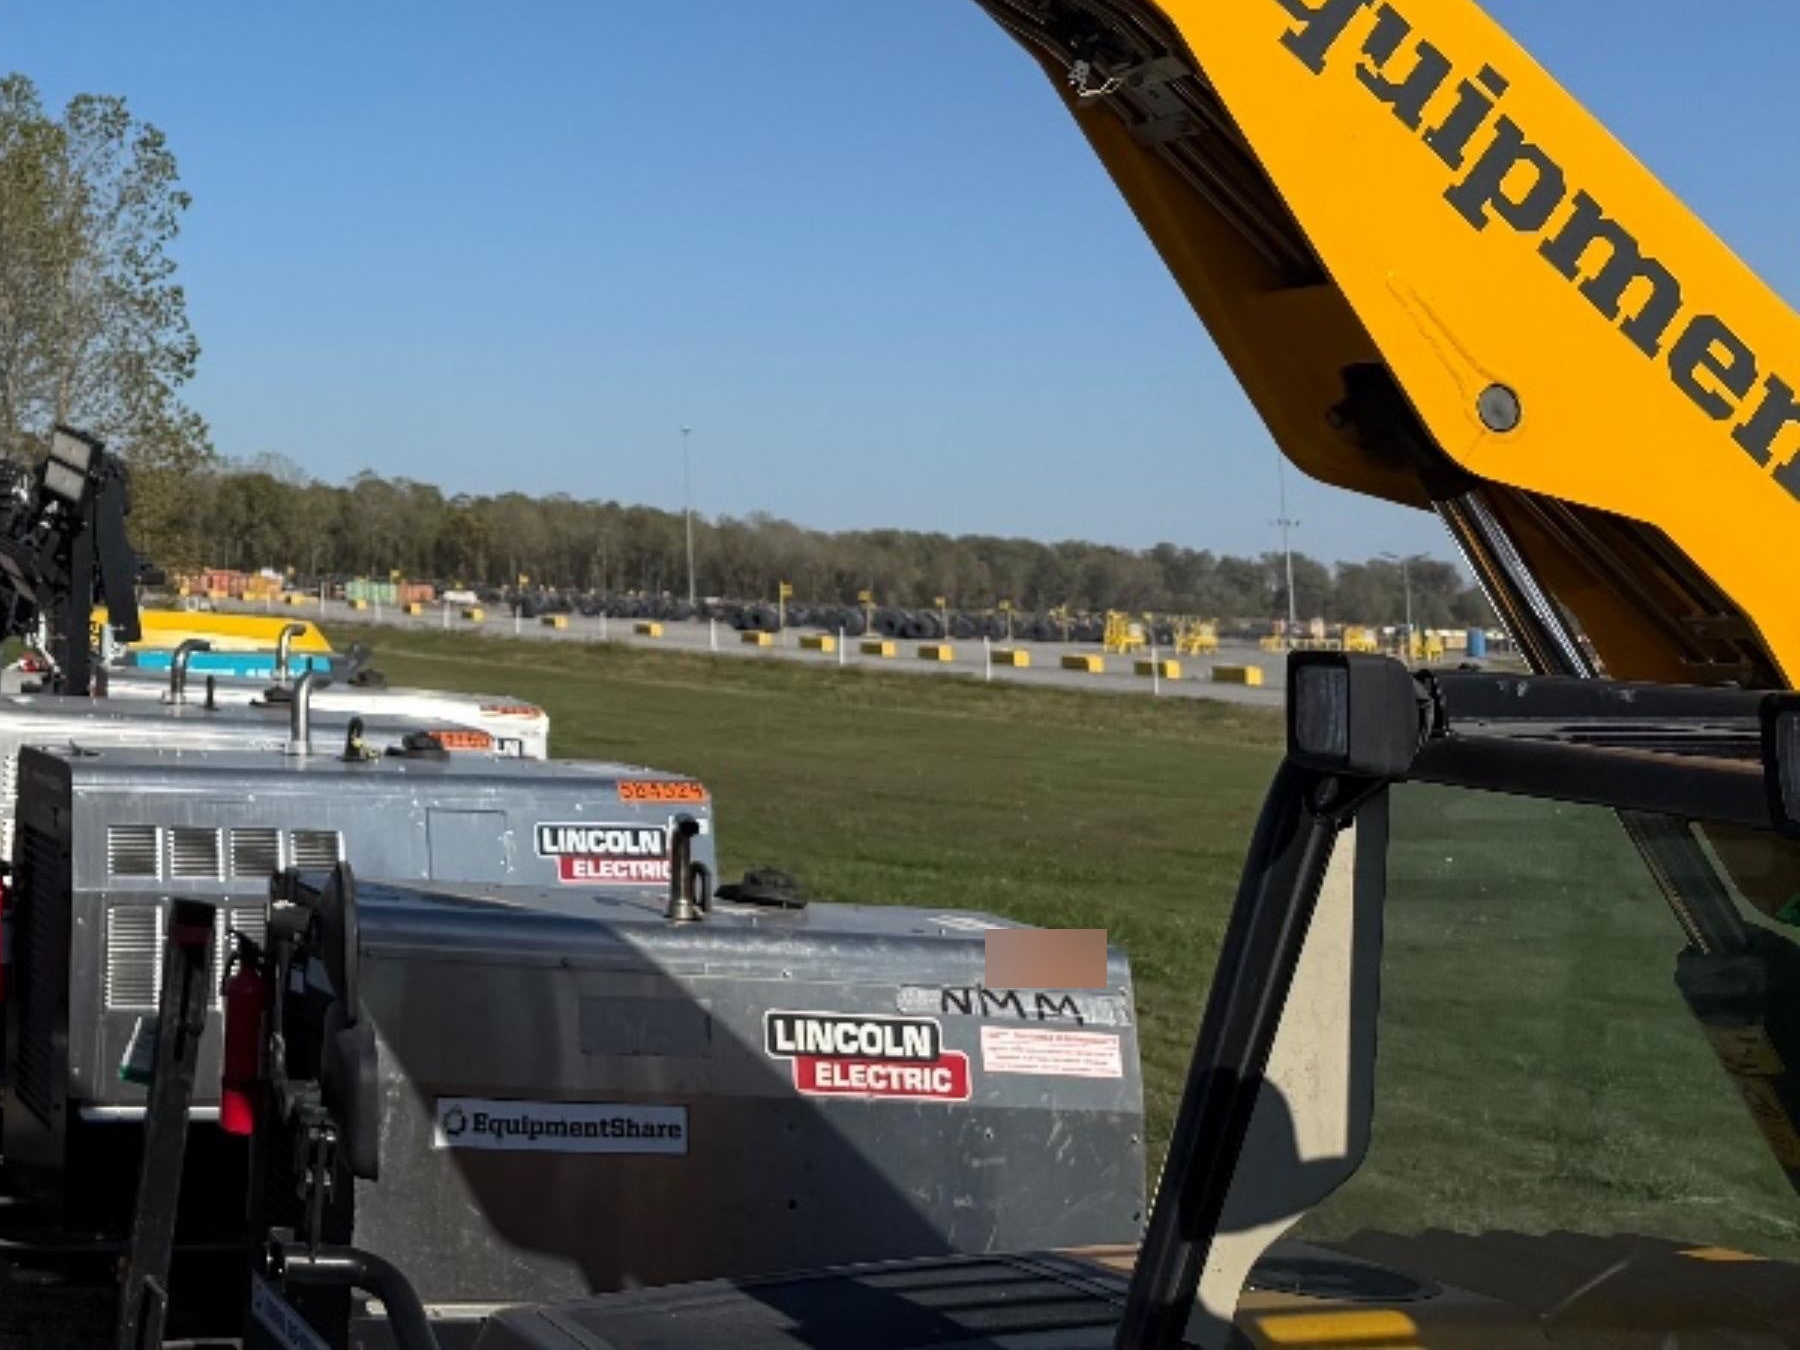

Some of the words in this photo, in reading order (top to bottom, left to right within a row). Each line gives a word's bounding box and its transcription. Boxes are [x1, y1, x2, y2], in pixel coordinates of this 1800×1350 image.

[542, 827, 663, 855] LINCOLN
[774, 1019, 932, 1058] LINCOLN
[815, 1061, 952, 1093] ELECTRIC
[472, 1112, 682, 1141] EquipmentShare
